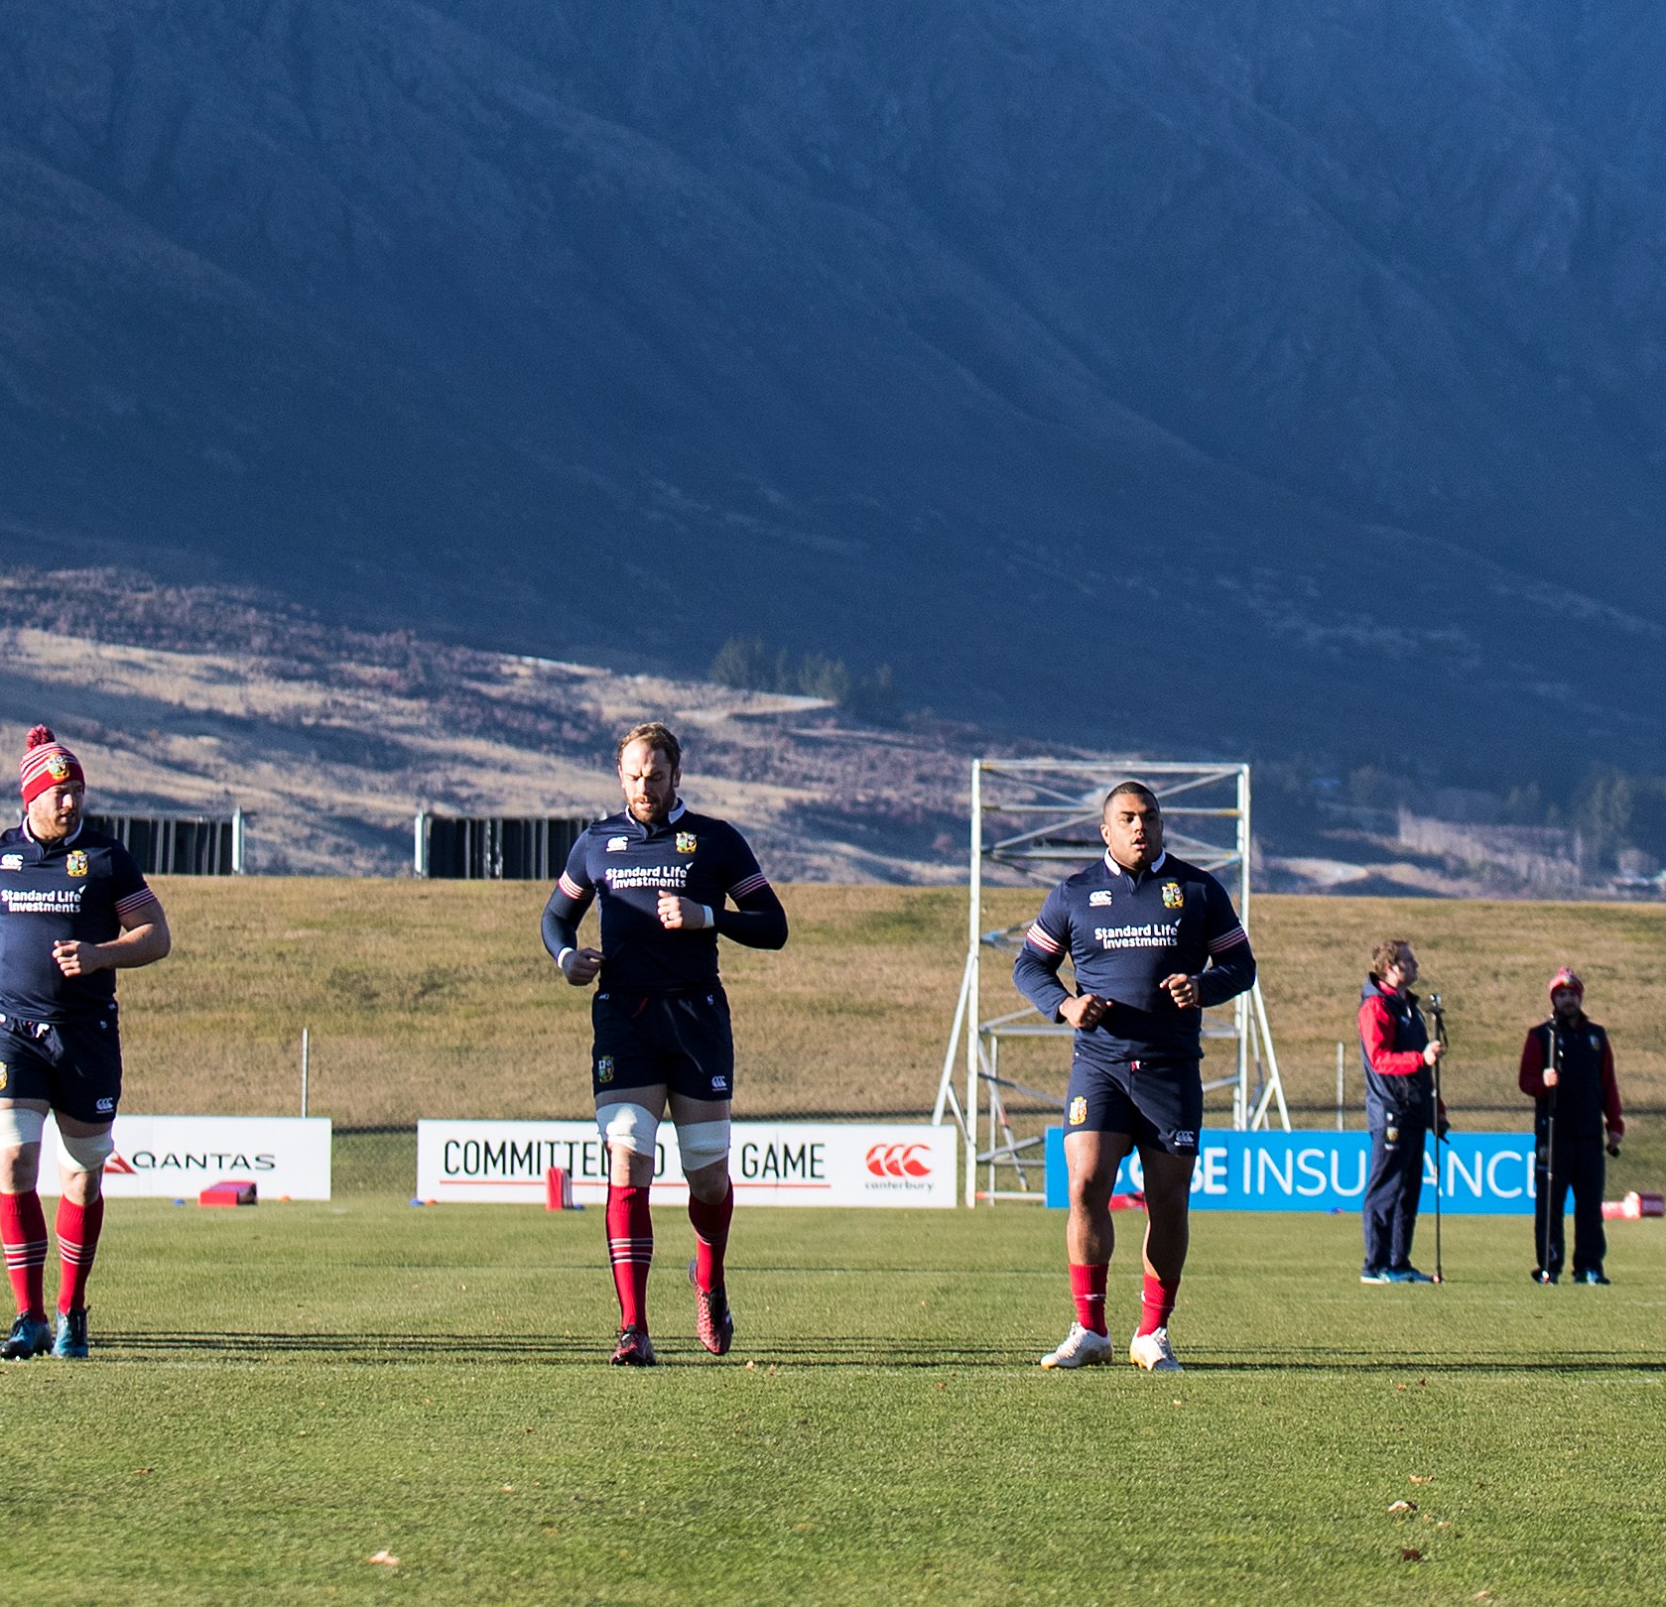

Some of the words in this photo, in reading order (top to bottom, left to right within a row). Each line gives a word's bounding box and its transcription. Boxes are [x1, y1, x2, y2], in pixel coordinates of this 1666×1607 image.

[605, 866, 660, 880] Standard
[663, 866, 687, 878] Life
[613, 876, 686, 889] Investments
[1, 889, 55, 902] Standard
[58, 891, 81, 902] Life
[9, 902, 81, 912] Investments
[1095, 924, 1151, 940] Standard
[1153, 924, 1177, 936] Life
[1103, 936, 1177, 949] Investments
[133, 1151, 276, 1171] QANTAS
[741, 1143, 825, 1179] GAME
[1243, 1147, 1536, 1198] INSUANC
[865, 1180, 933, 1192] canterbury
